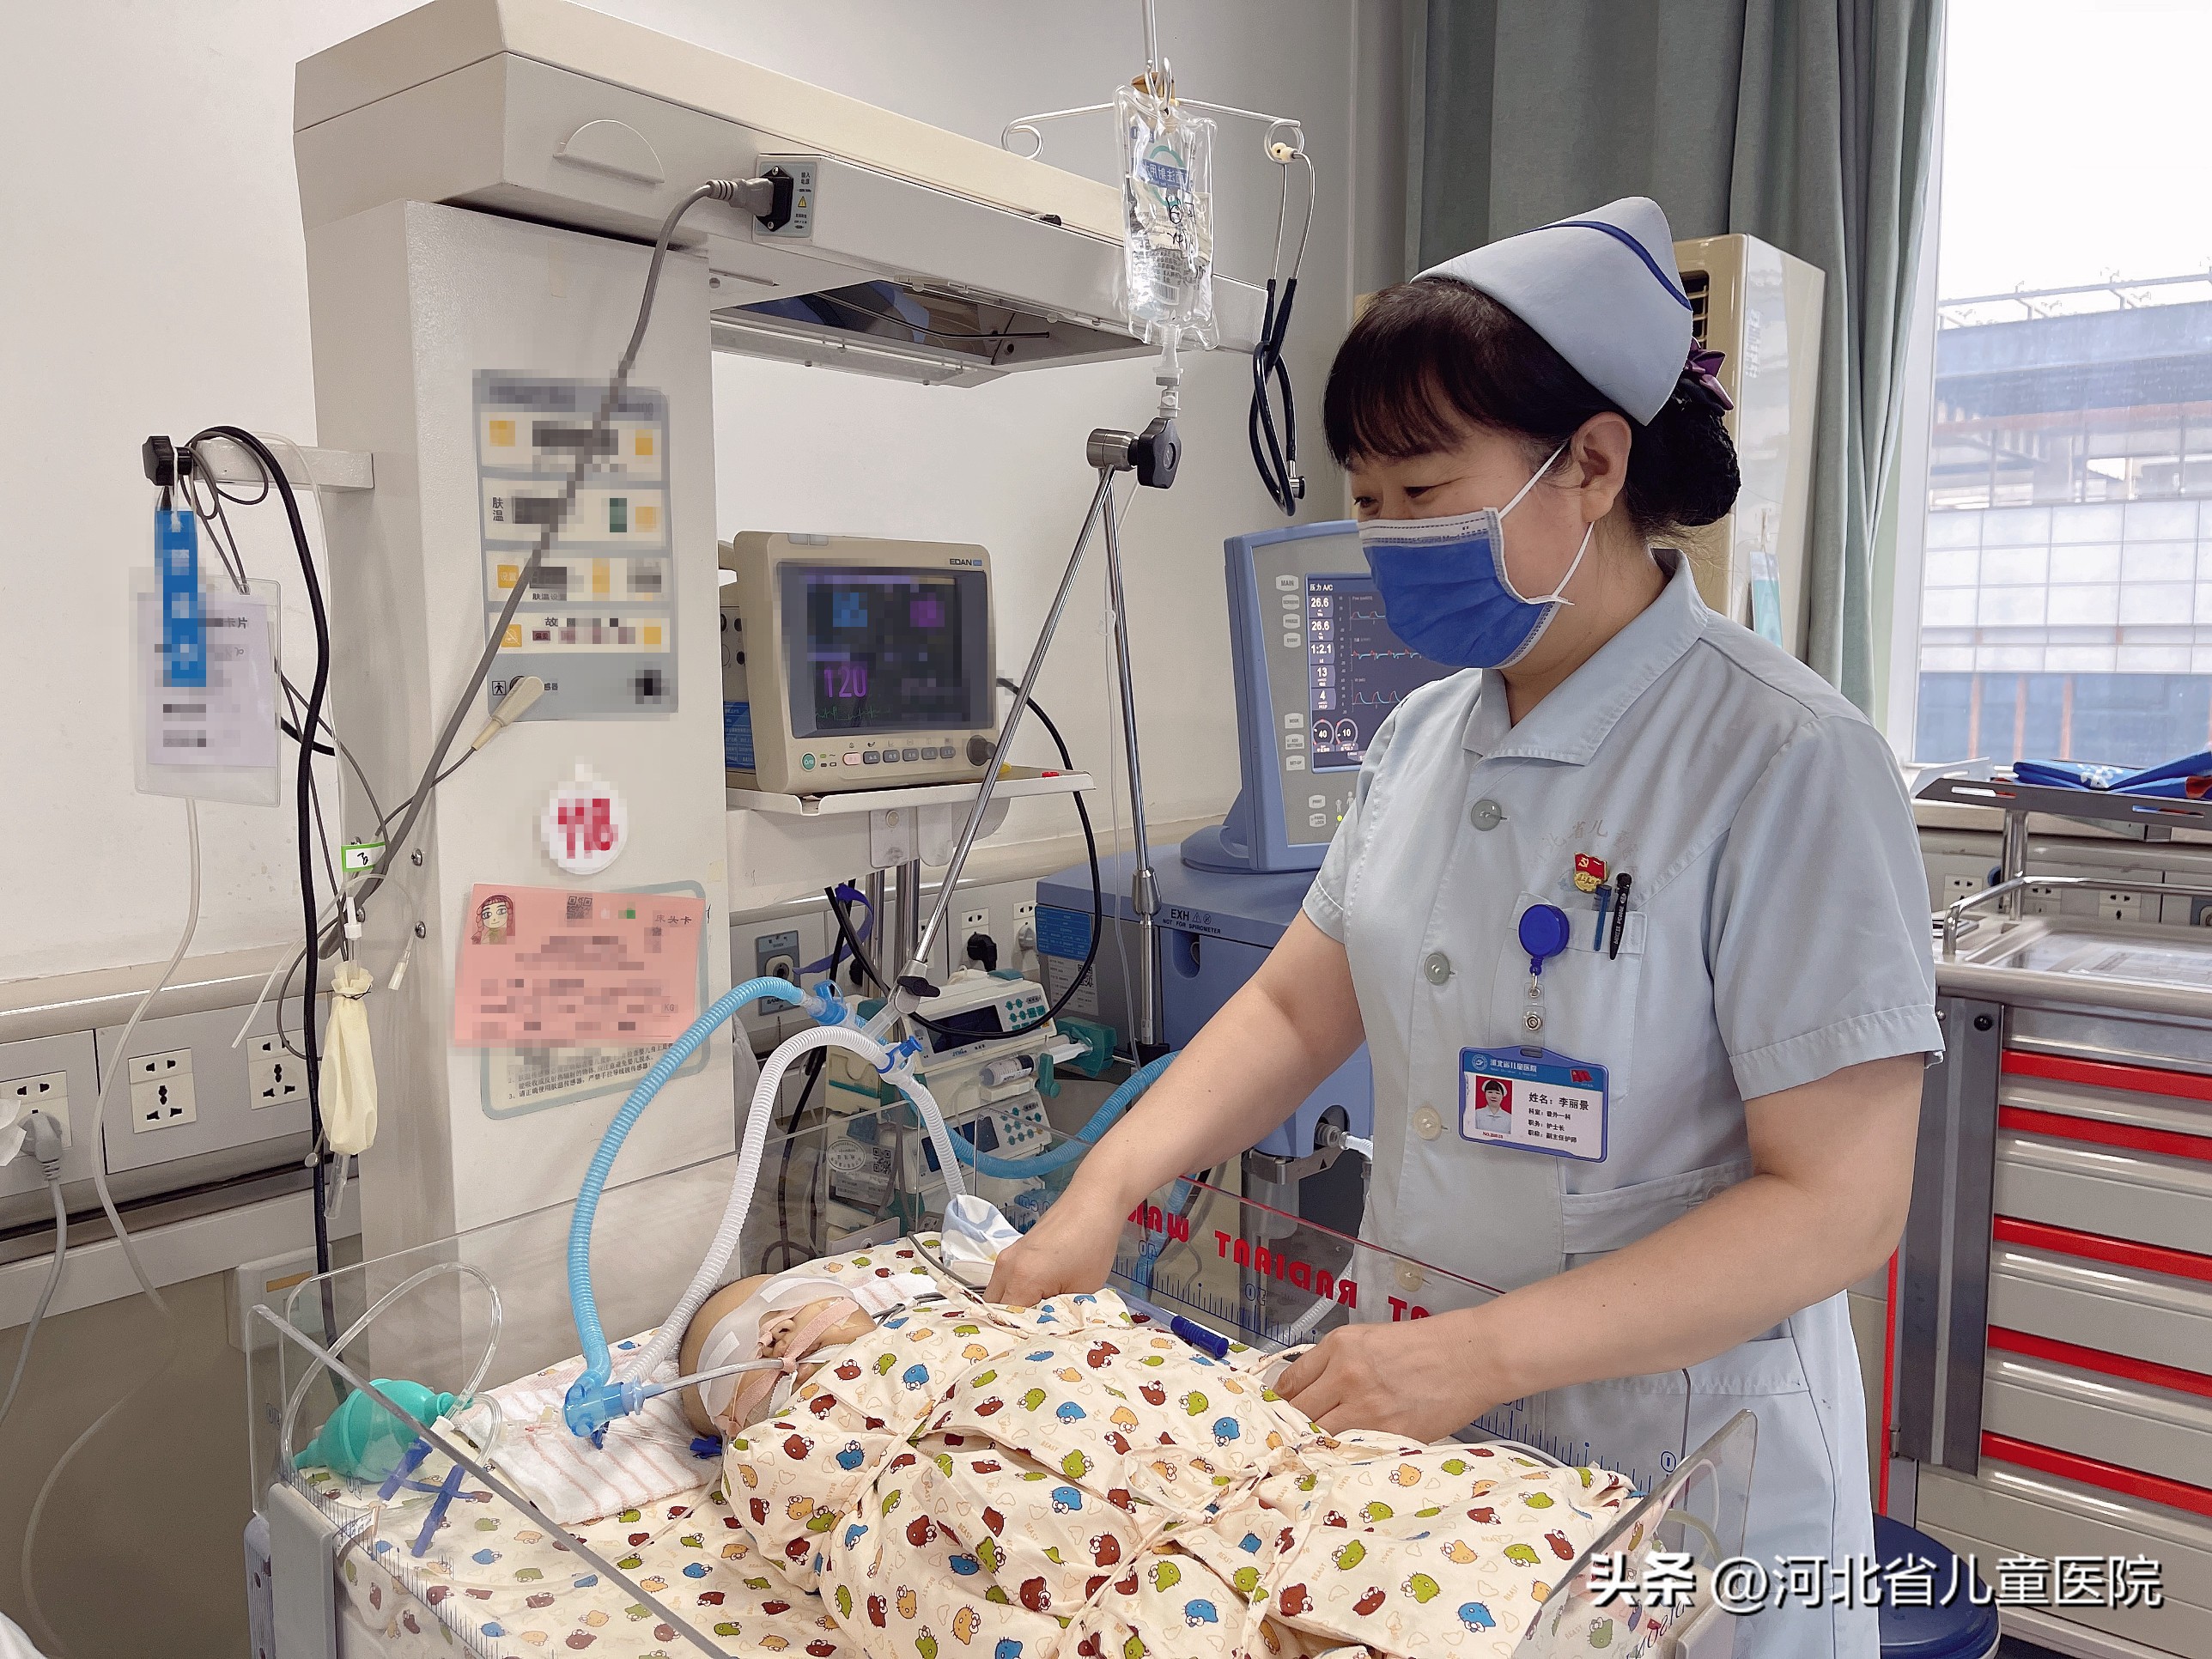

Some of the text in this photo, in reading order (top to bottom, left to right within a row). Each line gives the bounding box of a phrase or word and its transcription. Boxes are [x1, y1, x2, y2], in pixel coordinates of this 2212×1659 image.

[1310, 598, 1329, 608] 26.6
[1311, 621, 1330, 631] 26.6
[1311, 644, 1332, 654] 1:2.1
[1316, 667, 1328, 678] 13
[1319, 690, 1327, 701] 4
[1318, 729, 1328, 738] 40
[1342, 728, 1352, 737] 10
[1170, 908, 1190, 921] EXH
[1188, 923, 1222, 934] SPIROMETER
